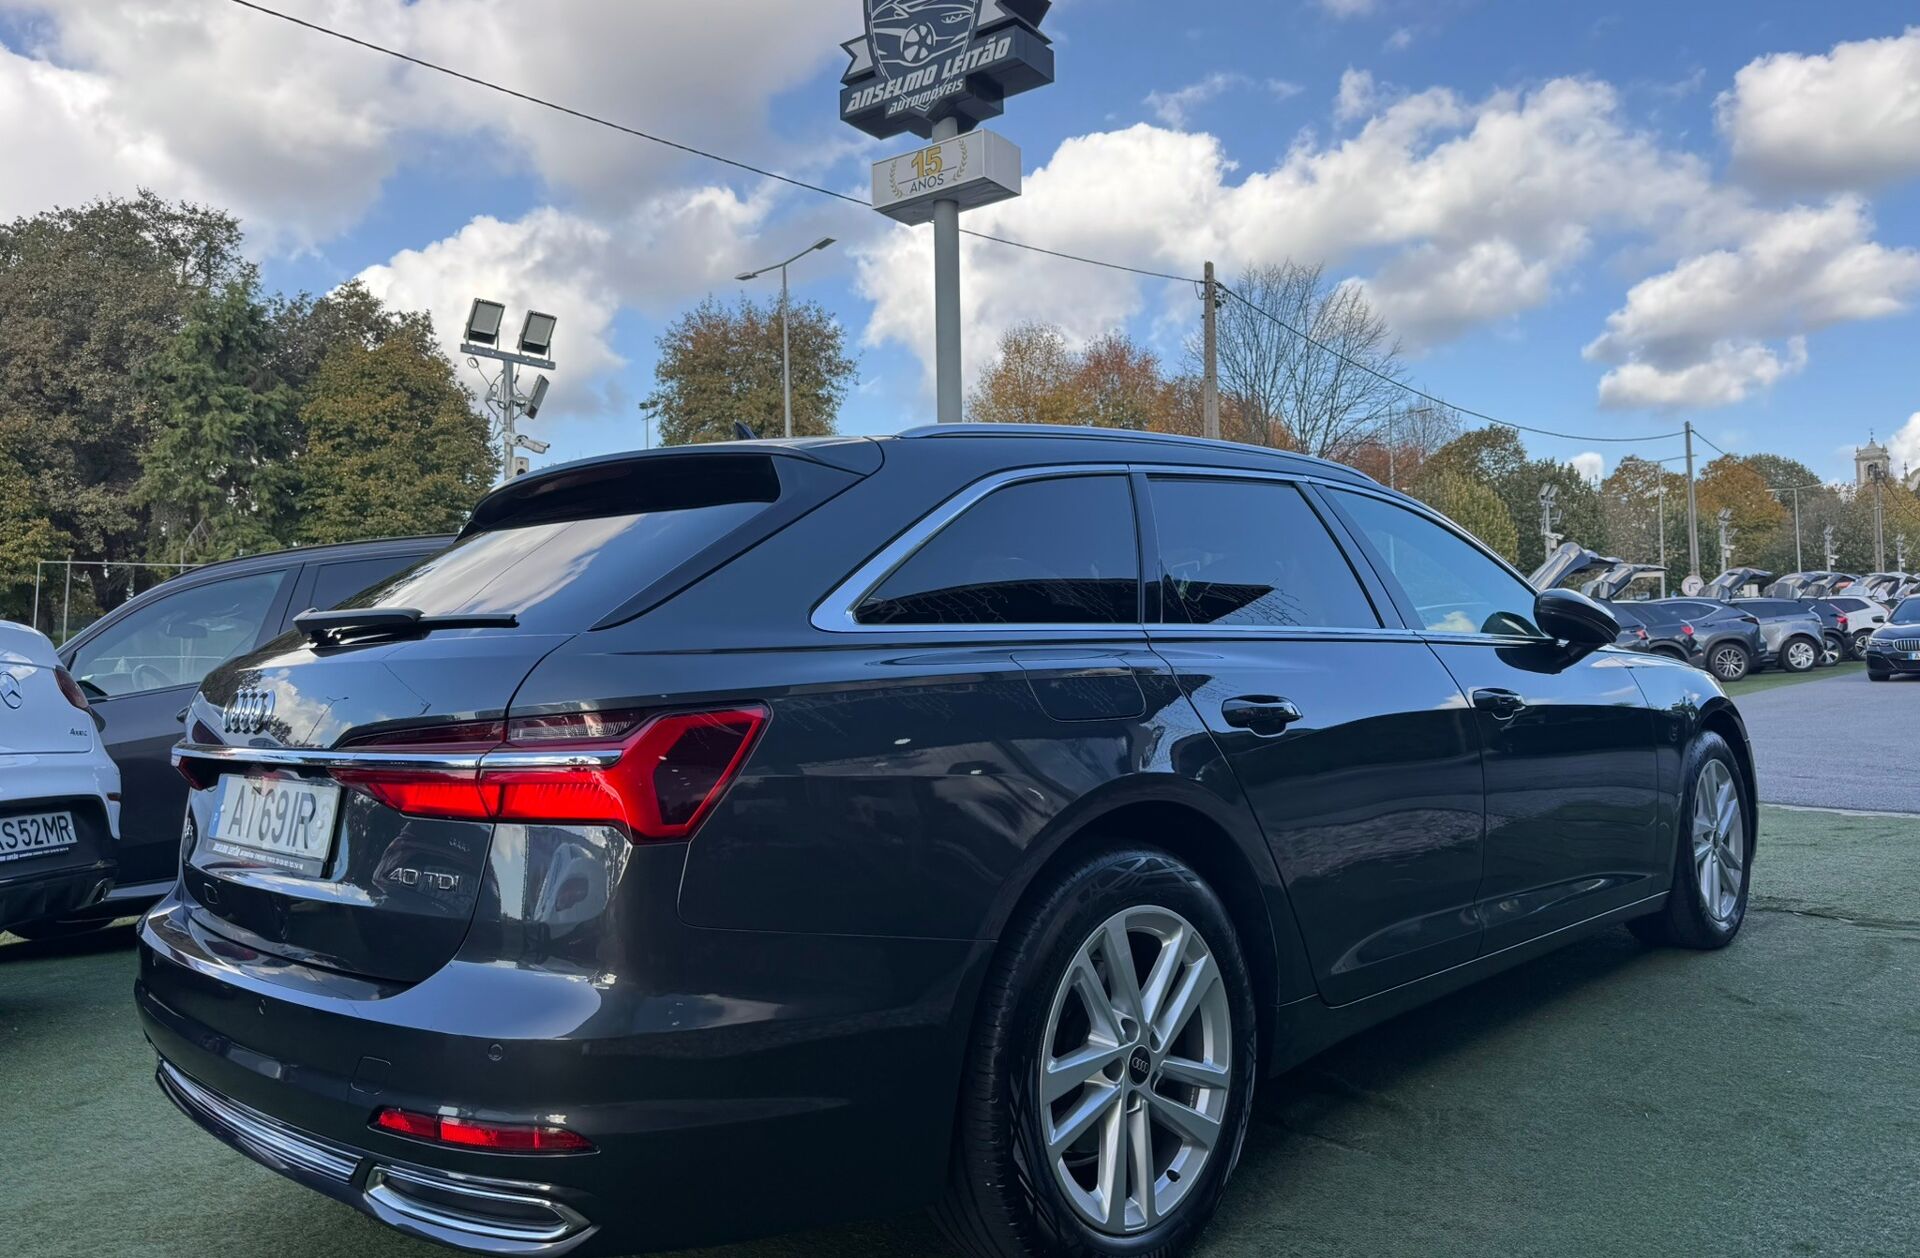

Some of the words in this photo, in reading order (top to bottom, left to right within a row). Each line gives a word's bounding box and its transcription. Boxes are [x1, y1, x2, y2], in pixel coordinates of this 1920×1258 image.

[845, 64, 938, 113] ANSELMO
[941, 36, 1012, 80] LEITÃO
[911, 145, 943, 179] 15
[910, 173, 945, 194] ANOS
[0, 815, 72, 851] S52MR
[388, 867, 419, 885] 40
